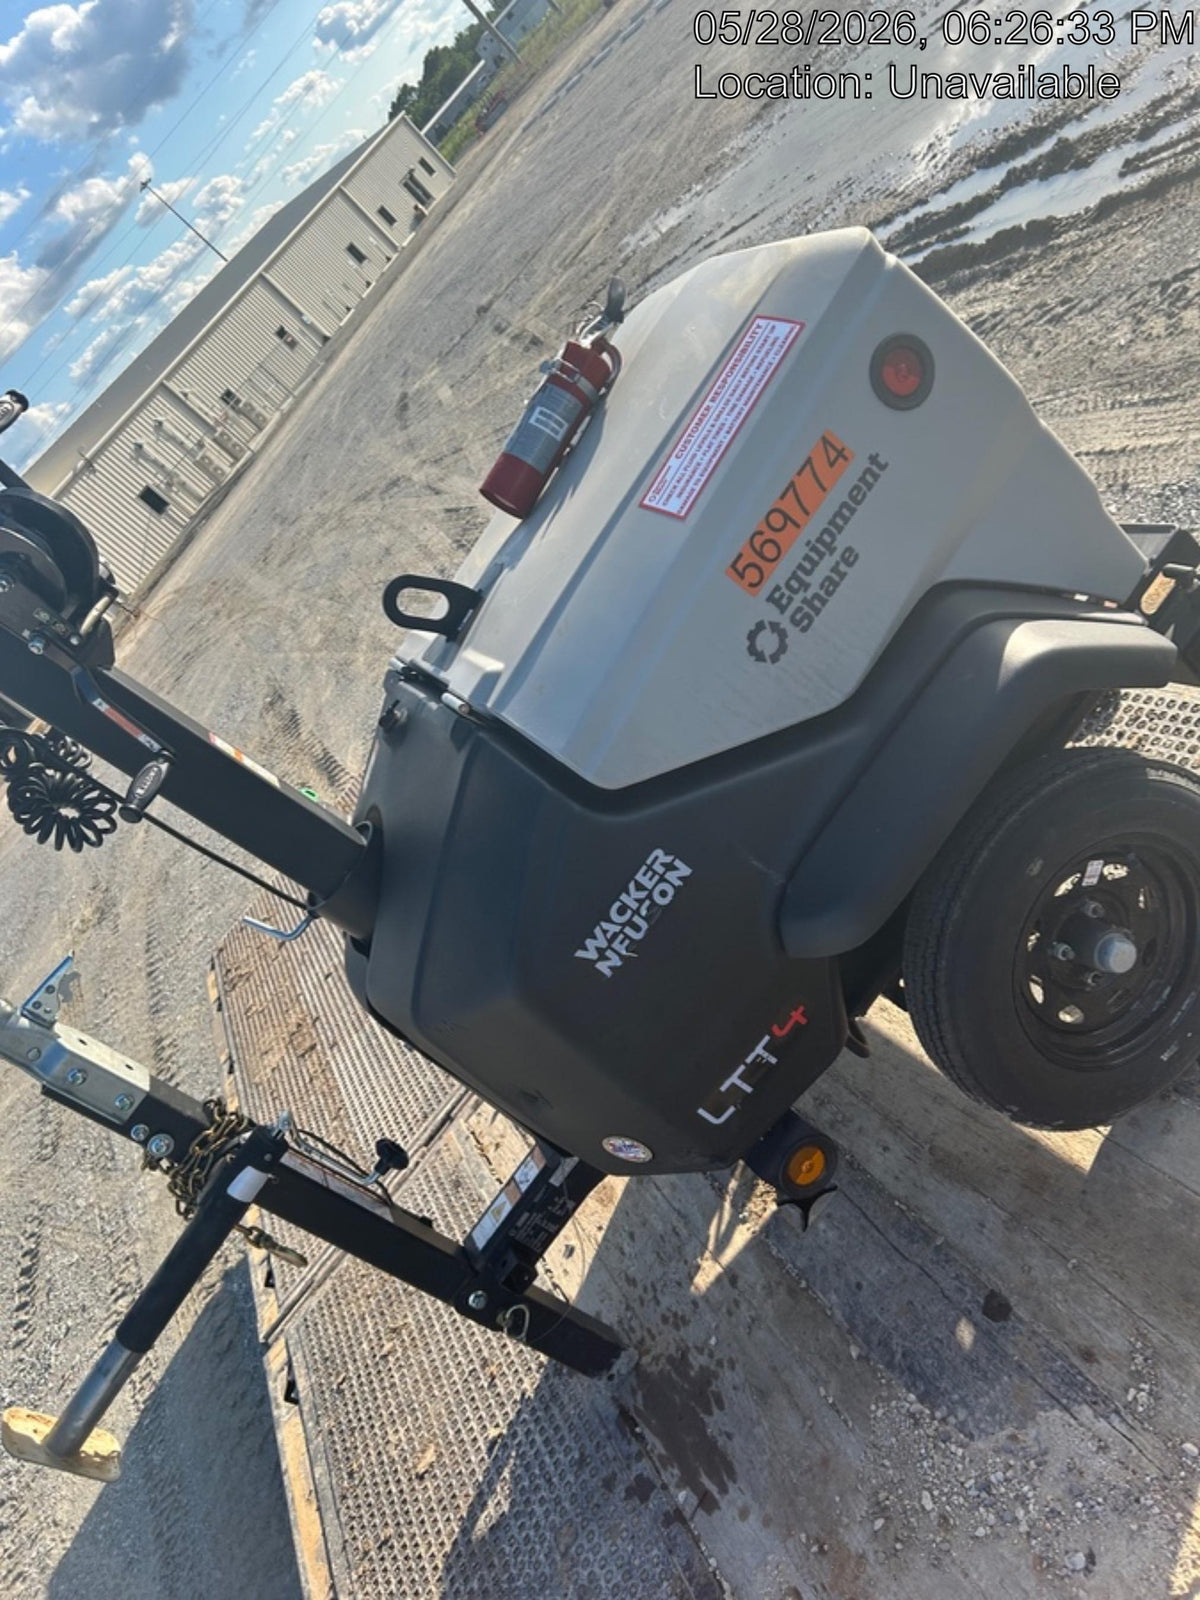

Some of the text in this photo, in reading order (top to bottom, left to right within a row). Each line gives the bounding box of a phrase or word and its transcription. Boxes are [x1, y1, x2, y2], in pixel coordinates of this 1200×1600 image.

[673, 321, 764, 459] CUSTOMER RESPONSIBILITY
[730, 434, 849, 589] 569774
[765, 451, 889, 616] Equipment
[789, 545, 860, 634] Share
[574, 847, 675, 961] WACKER
